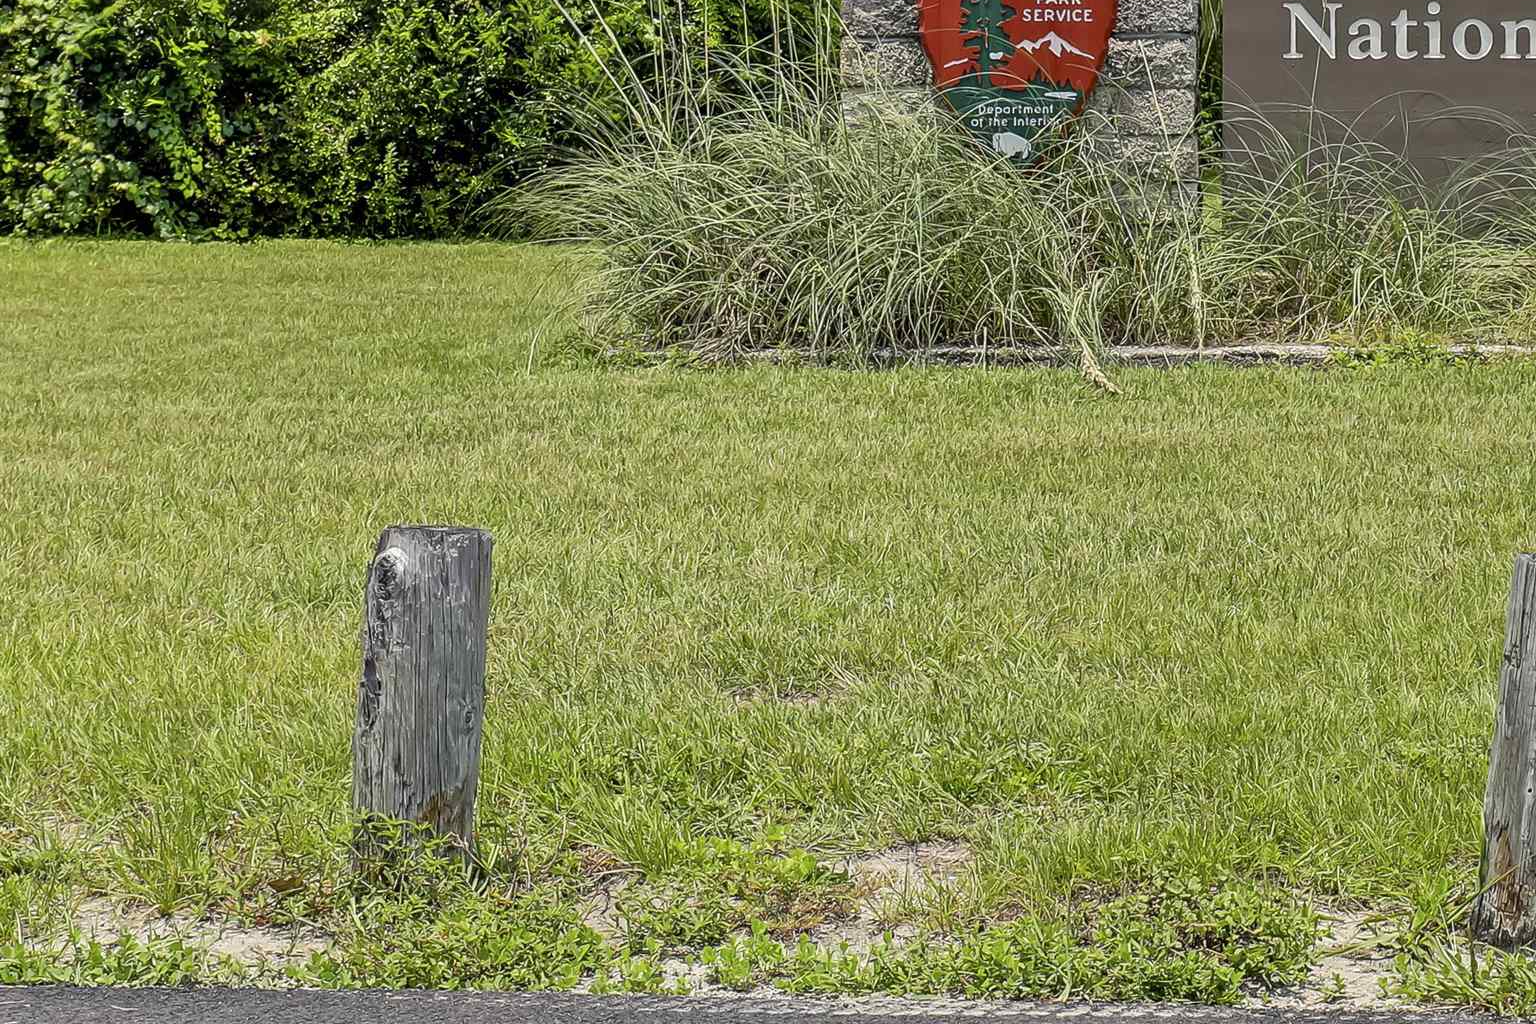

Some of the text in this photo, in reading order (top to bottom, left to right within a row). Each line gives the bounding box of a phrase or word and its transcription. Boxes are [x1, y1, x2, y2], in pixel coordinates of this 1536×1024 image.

[1022, 8, 1094, 22] SERVICE
[978, 104, 1054, 117] Department
[970, 118, 984, 128] of
[988, 117, 1009, 127] the
